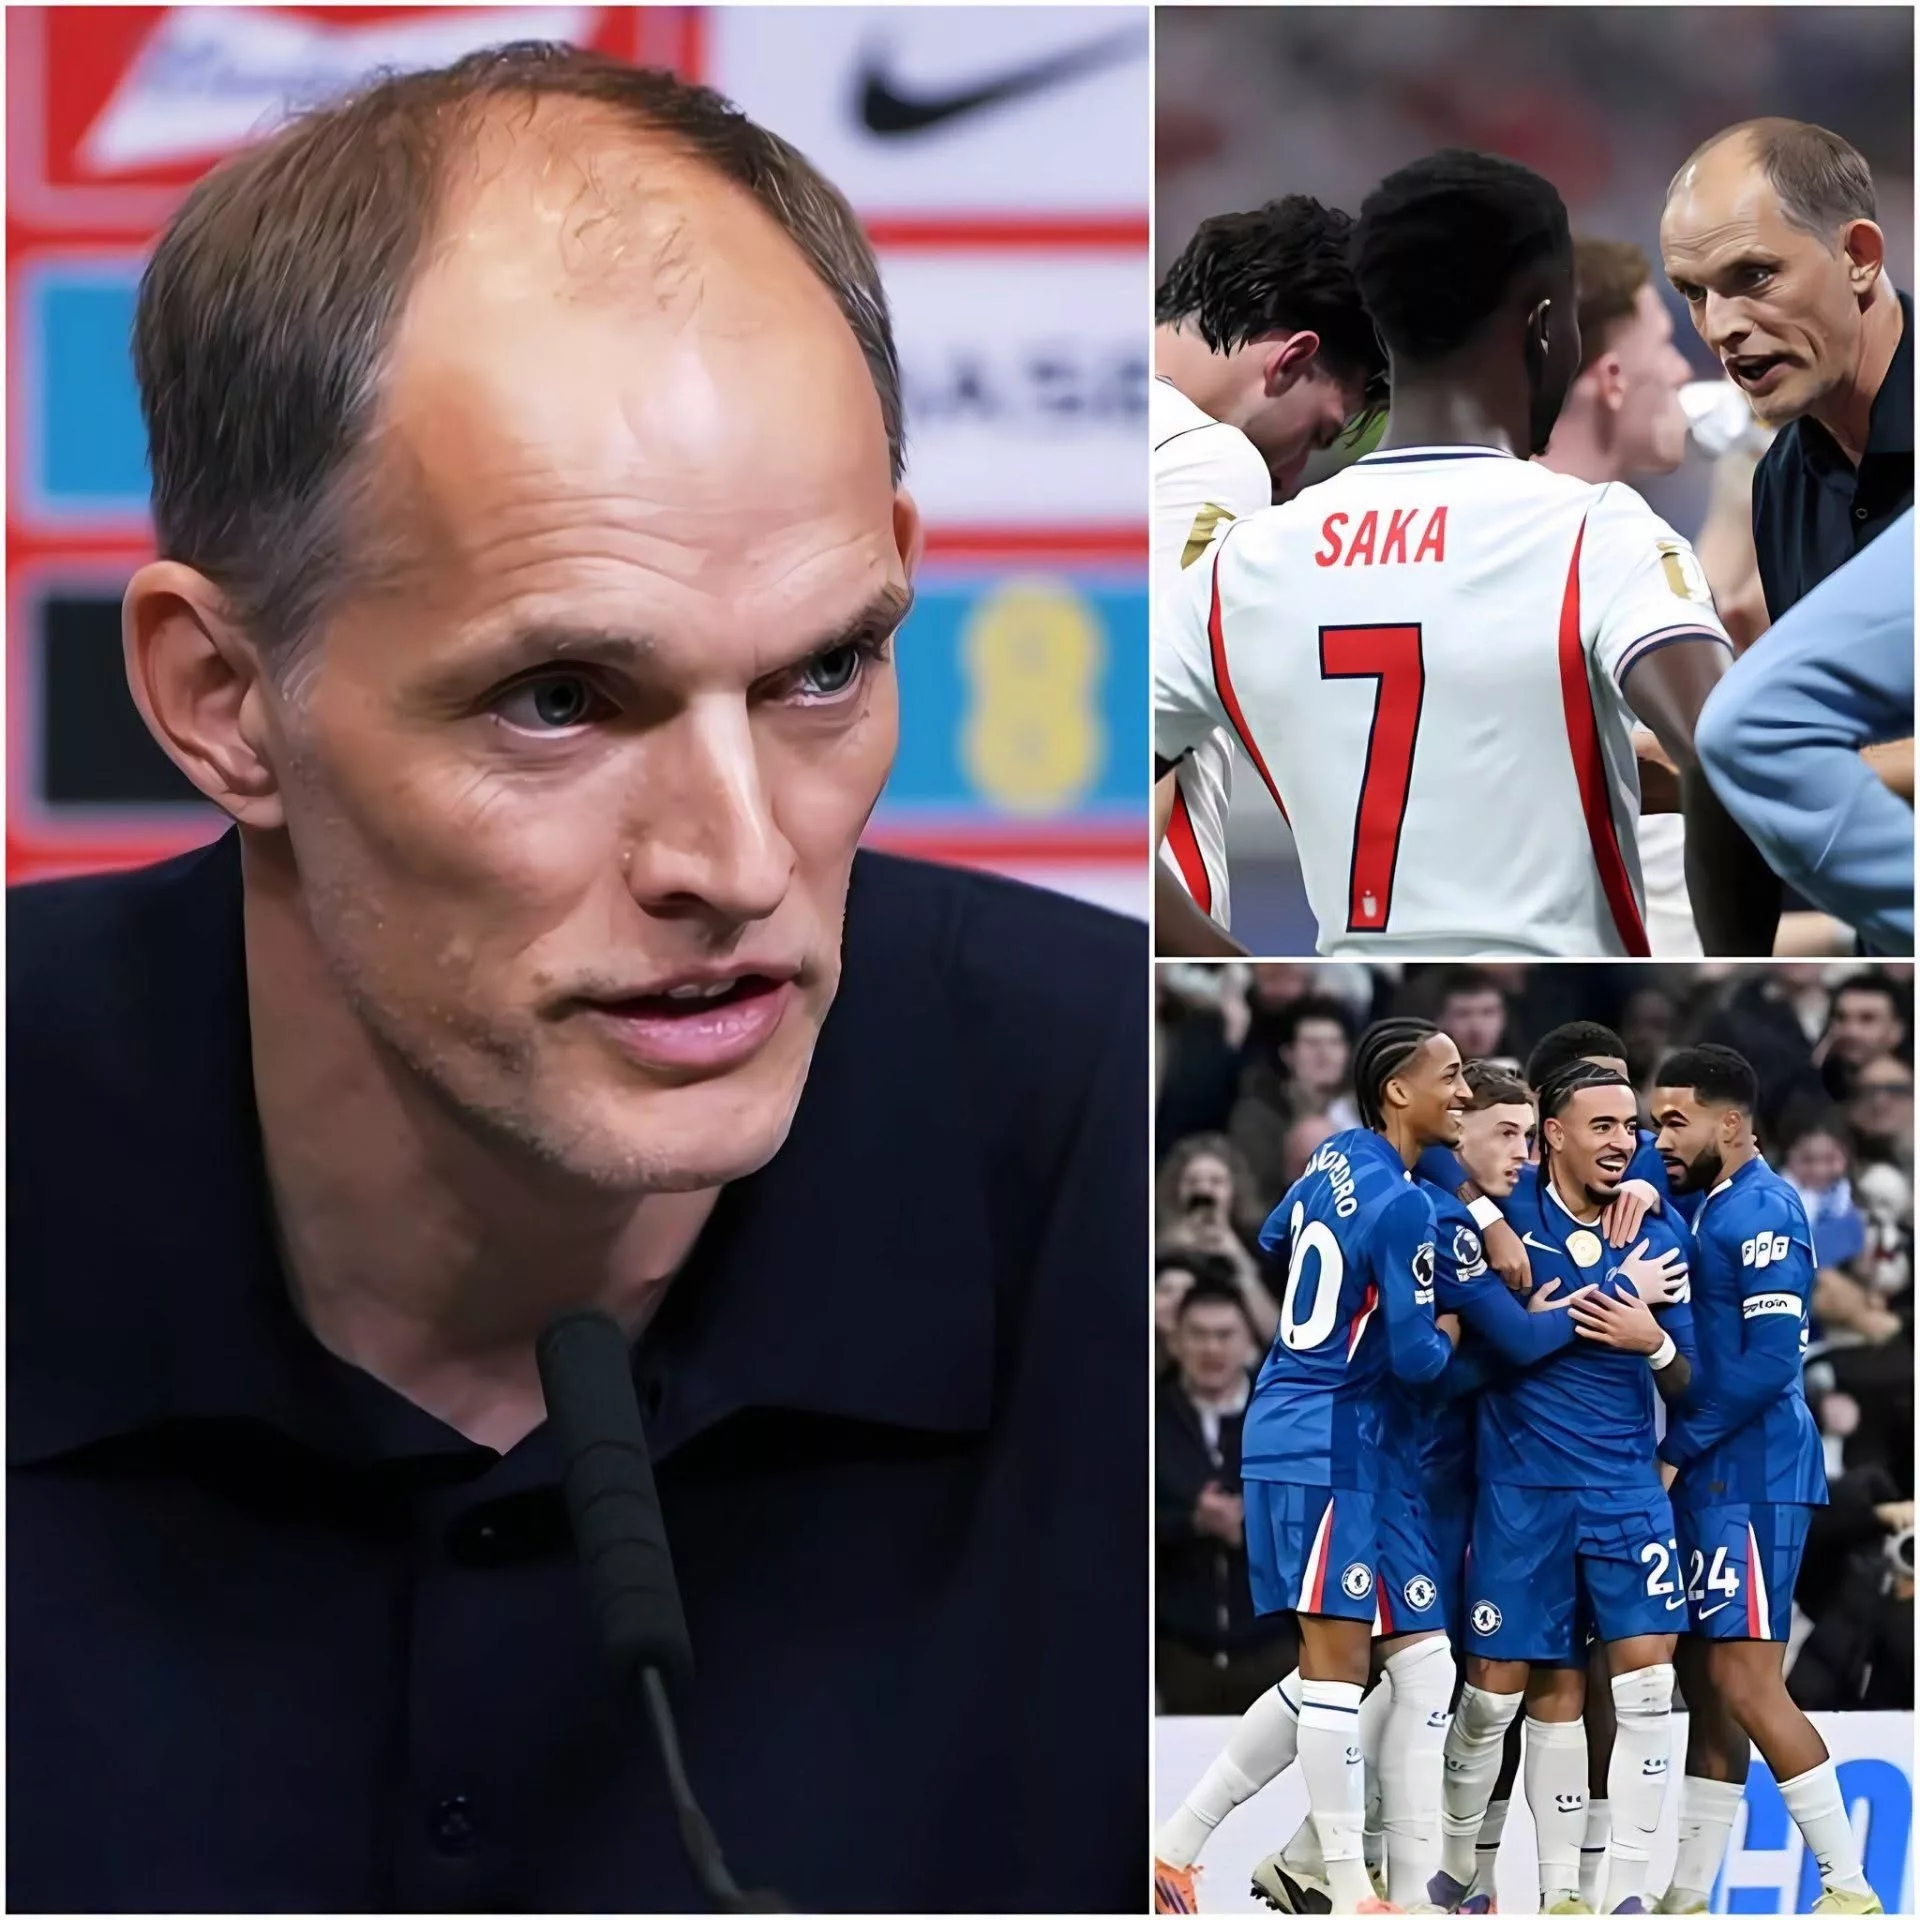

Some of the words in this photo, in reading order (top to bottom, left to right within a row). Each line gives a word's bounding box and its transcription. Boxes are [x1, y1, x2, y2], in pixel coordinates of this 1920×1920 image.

[1315, 505, 1448, 567] SAKA
[1319, 622, 1425, 932] 7
[1688, 1547, 1740, 1600] 24
